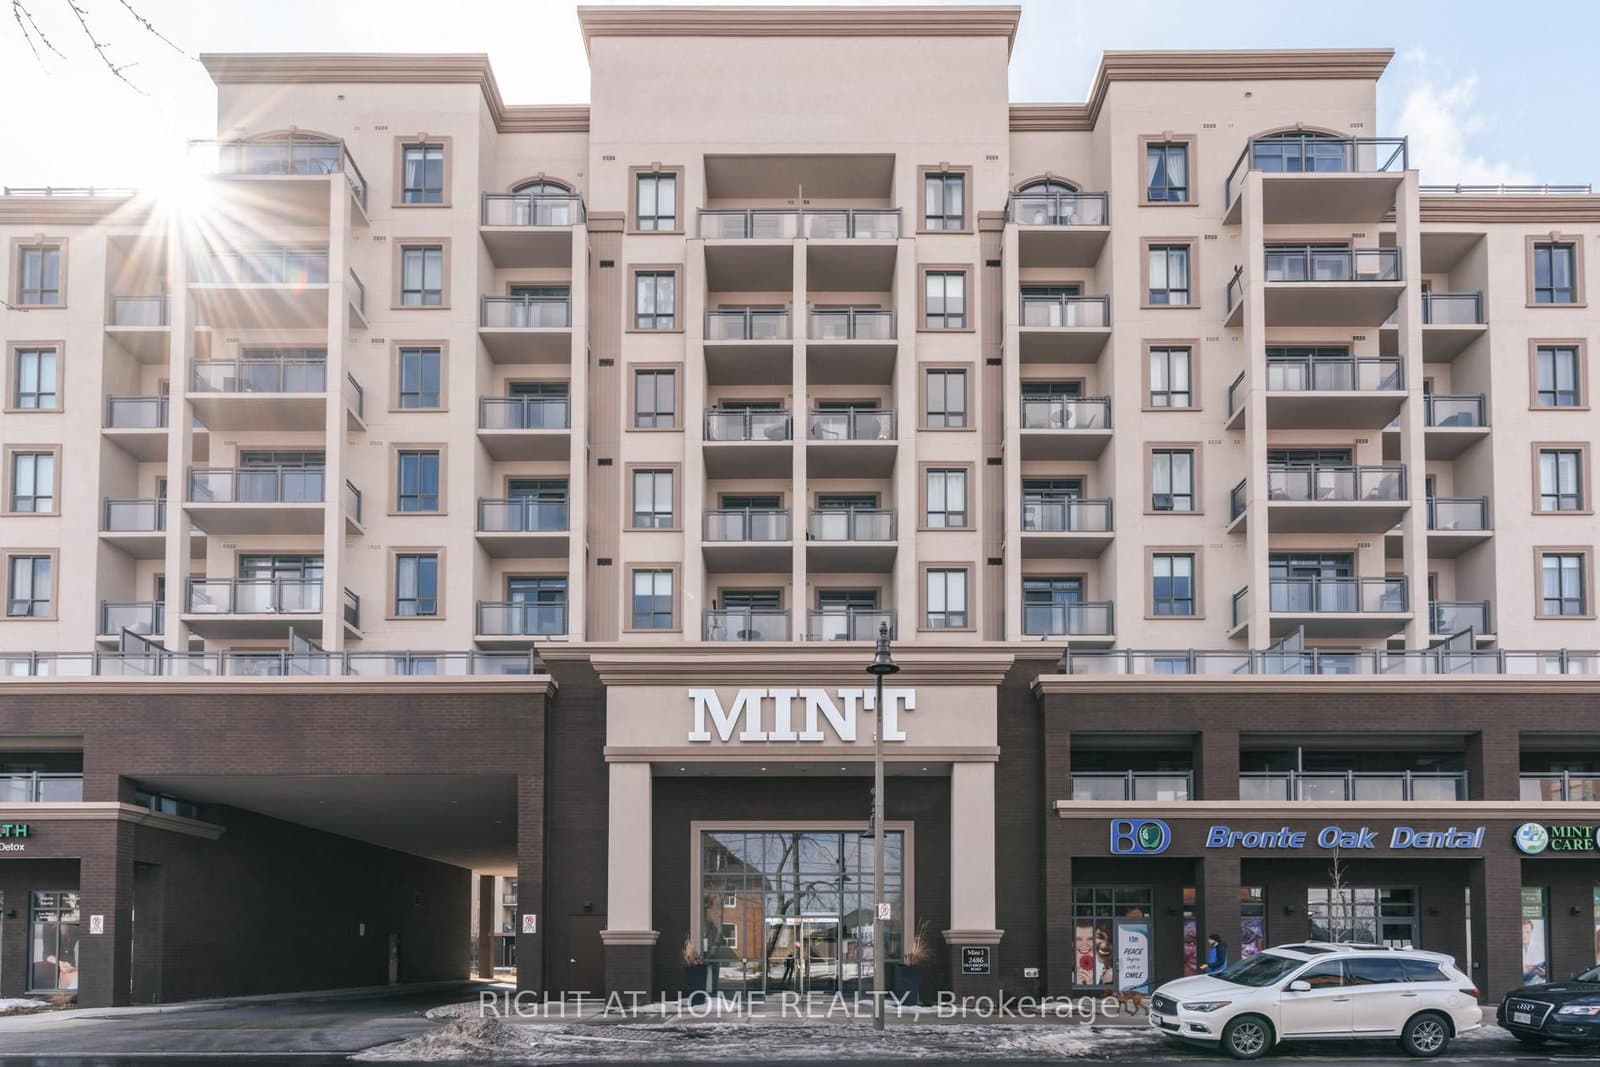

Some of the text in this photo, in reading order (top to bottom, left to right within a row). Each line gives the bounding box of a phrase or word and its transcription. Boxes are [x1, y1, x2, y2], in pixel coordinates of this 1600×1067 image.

[688, 688, 915, 741] MINT
[1206, 826, 1307, 848] Bronte
[1318, 826, 1379, 848] Oak
[1390, 826, 1486, 848] Dental
[1551, 826, 1593, 837] MINT
[1551, 838, 1594, 850] CARE
